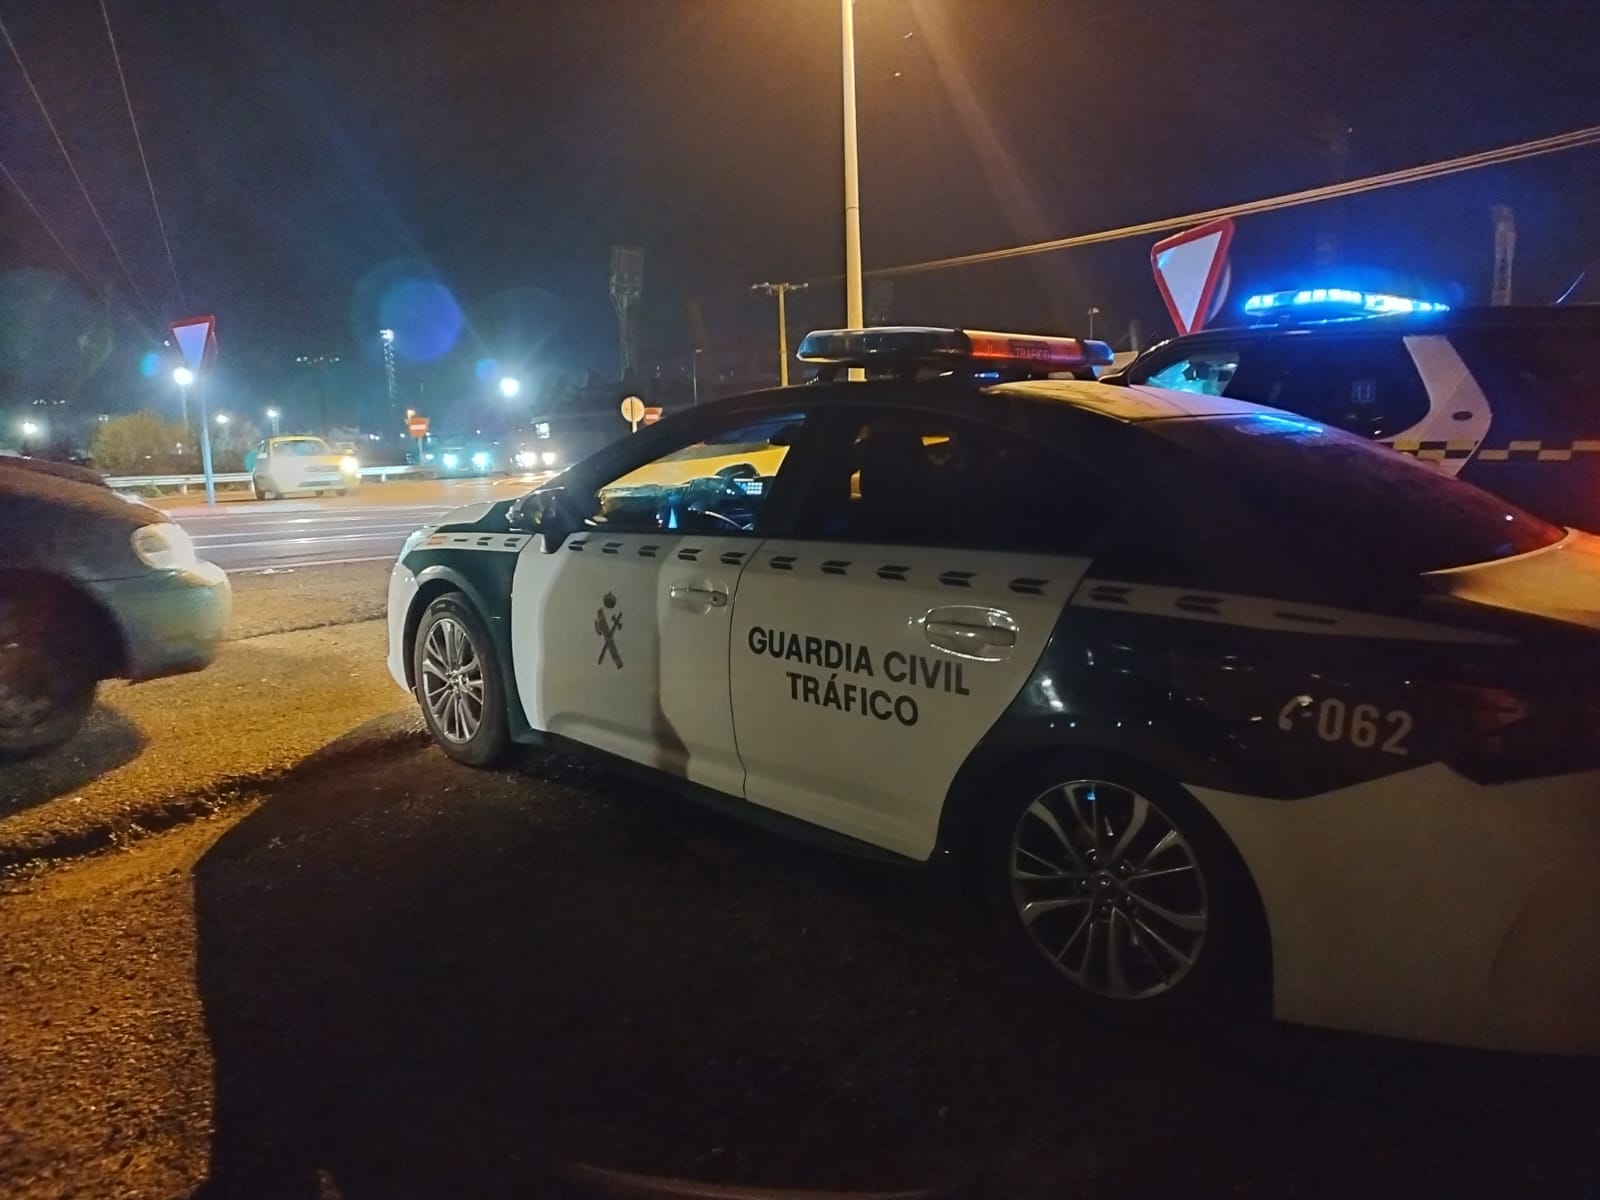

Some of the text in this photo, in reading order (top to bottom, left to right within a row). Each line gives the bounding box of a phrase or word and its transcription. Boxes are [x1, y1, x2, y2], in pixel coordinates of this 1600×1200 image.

[748, 626, 970, 696] GUARDIA CIVIL
[786, 672, 919, 727] TRÁFICO
[1318, 698, 1414, 756] 062
